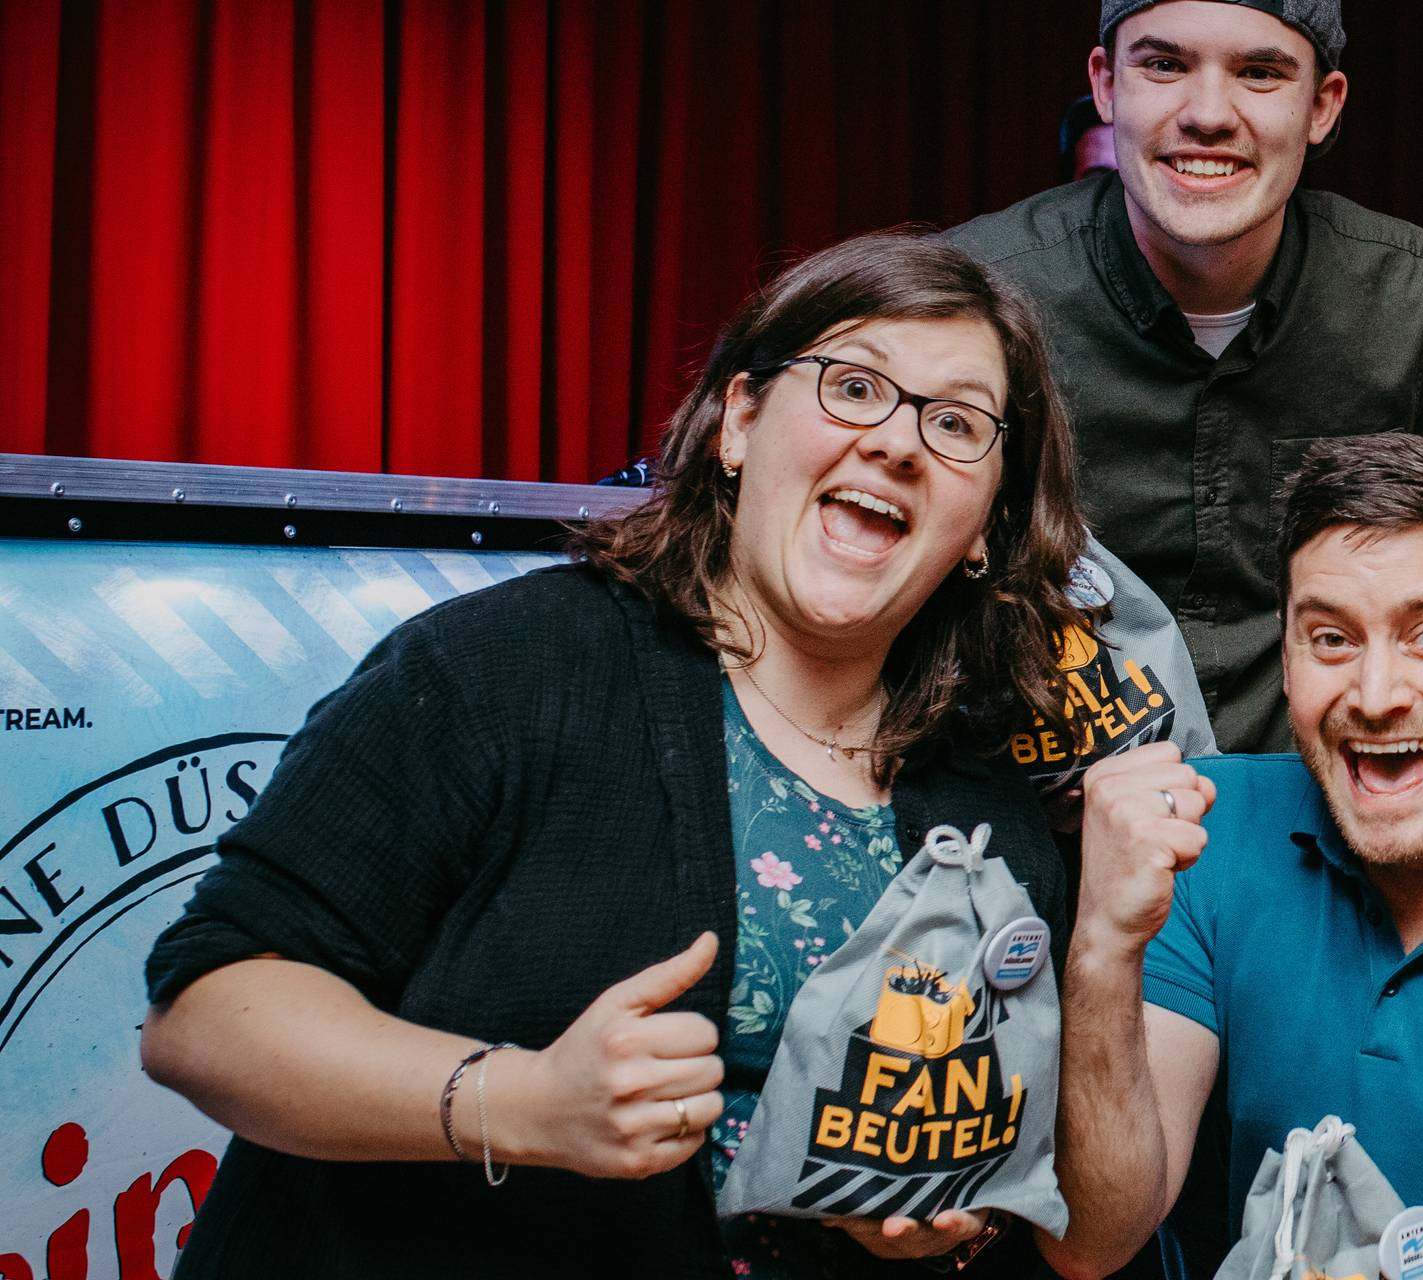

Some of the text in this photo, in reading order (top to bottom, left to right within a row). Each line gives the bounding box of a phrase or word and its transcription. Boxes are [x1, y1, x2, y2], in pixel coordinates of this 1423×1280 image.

[0, 706, 93, 731] REAM.
[859, 1051, 990, 1117] FAN
[815, 1073, 1023, 1165] BEUTEL!
